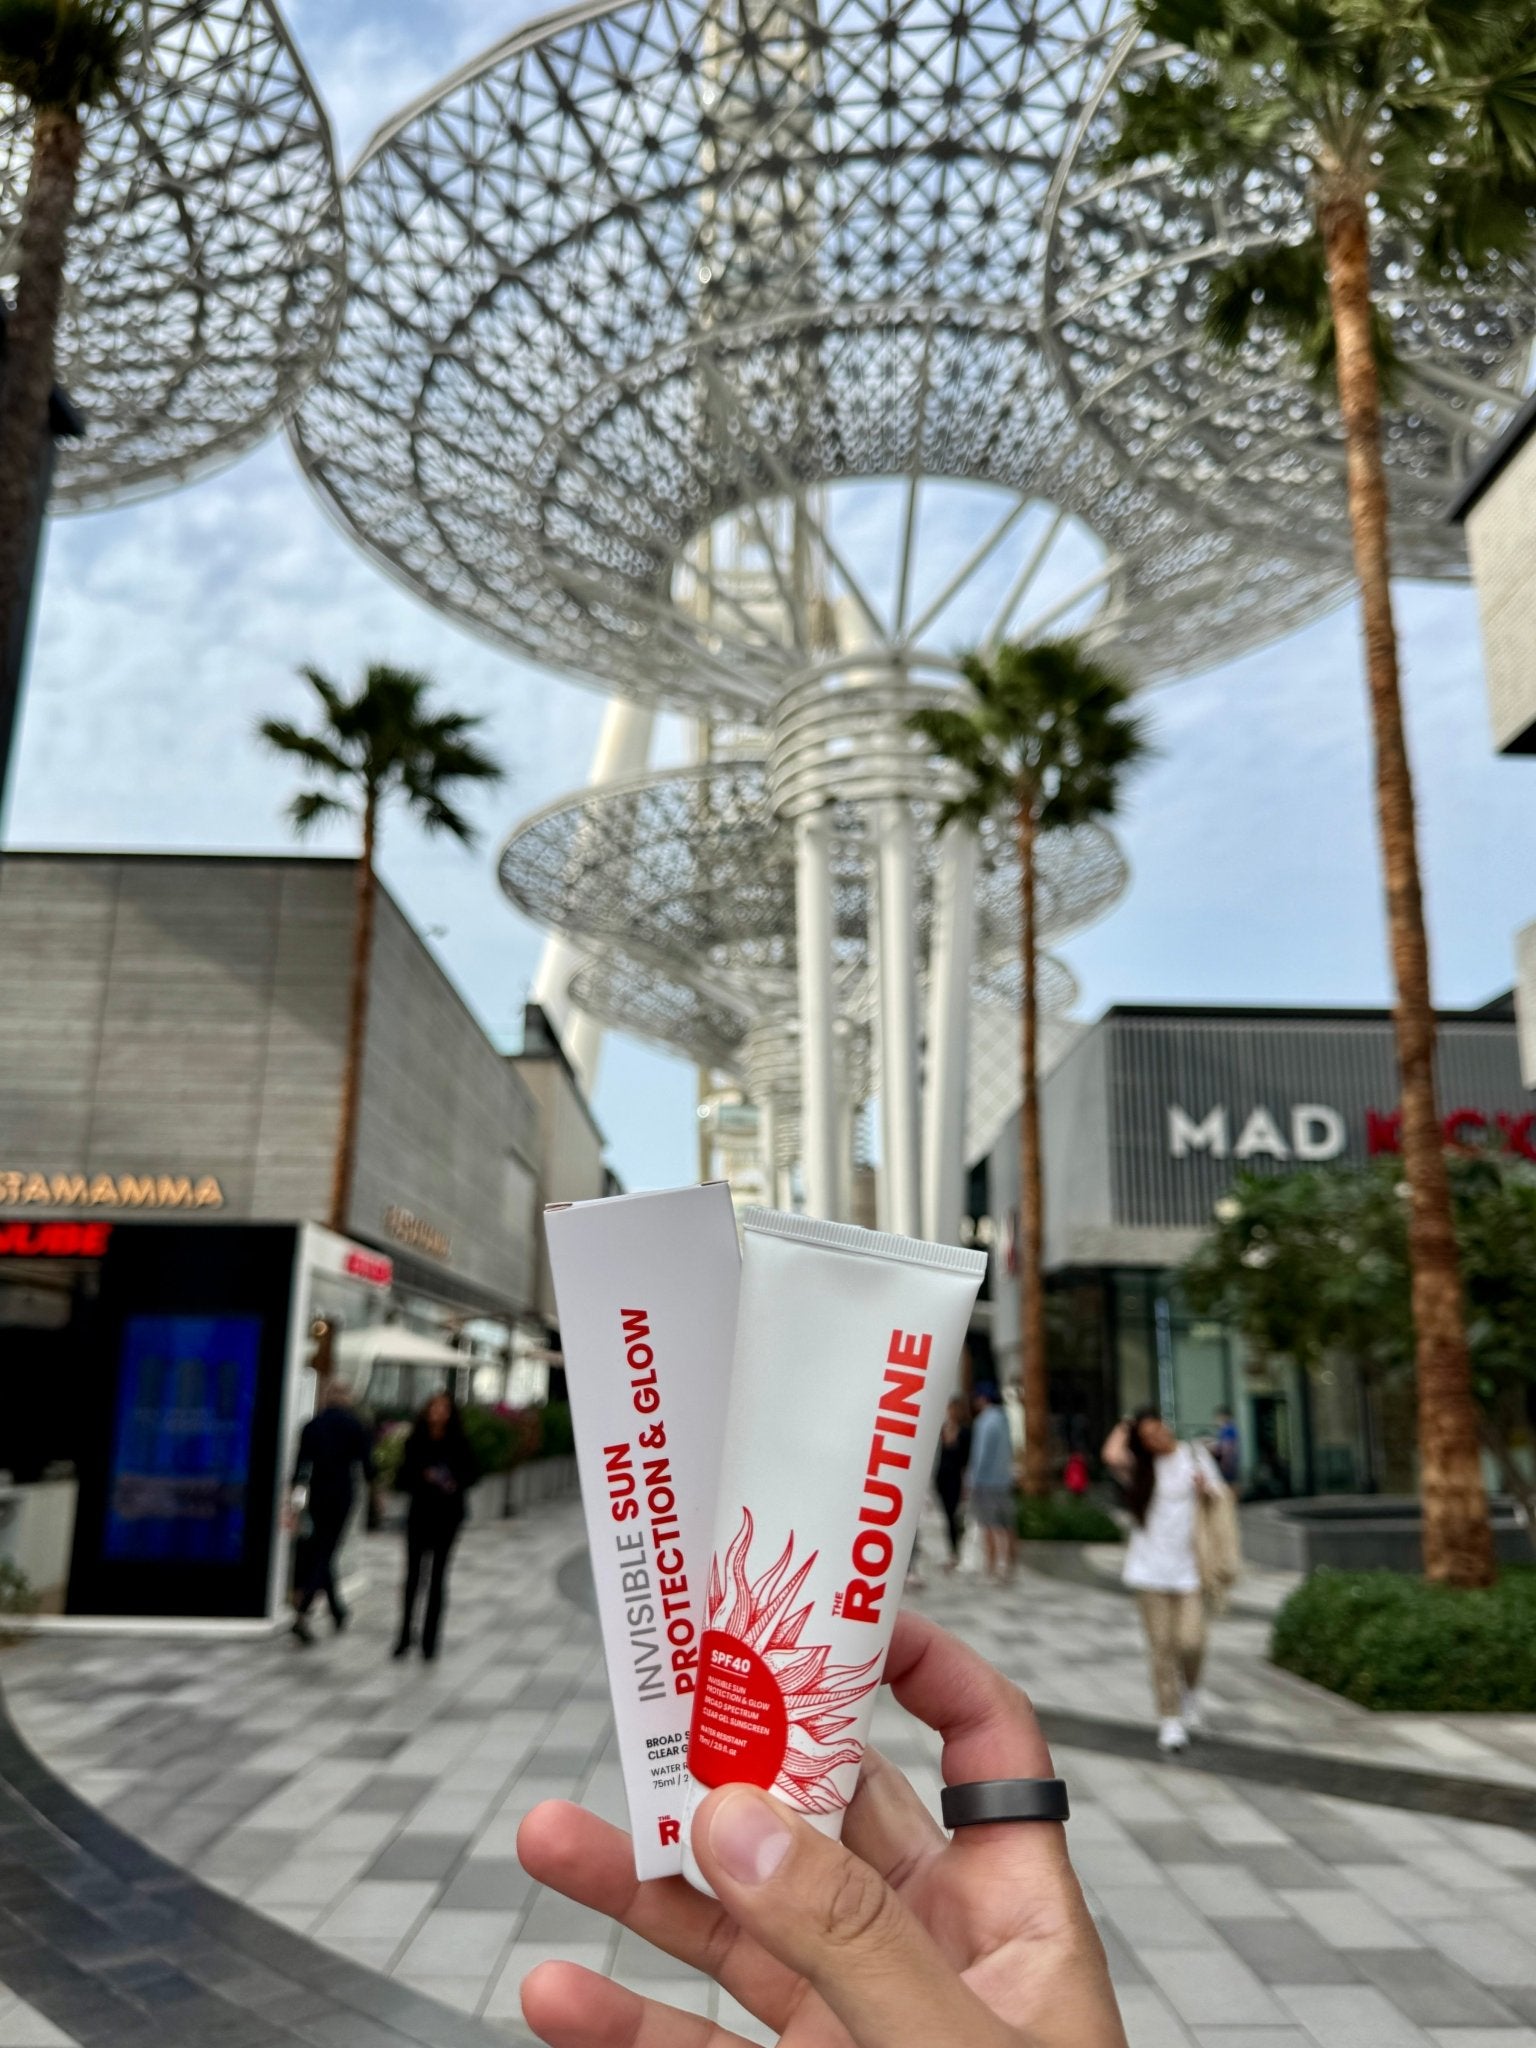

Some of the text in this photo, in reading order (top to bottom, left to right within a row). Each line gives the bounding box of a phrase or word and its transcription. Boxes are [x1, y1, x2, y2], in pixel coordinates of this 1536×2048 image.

[1168, 1102, 1346, 1161] MAD
[841, 1328, 932, 1624] ROUTINE
[620, 1309, 699, 1695] PROTECTION & GLOW
[603, 1443, 666, 1701] INVISIBLE SUN
[832, 1591, 844, 1617] THE
[711, 1649, 751, 1673] SPF40
[706, 1684, 741, 1702] PROTECTION
[748, 1699, 770, 1710] GLOW
[732, 1684, 747, 1695] SUN
[704, 1695, 760, 1720] BROAD SPECTRUM
[702, 1707, 770, 1735] CLEAR GEL SUNSCREEN
[646, 1733, 682, 1748] BROAD
[717, 1731, 748, 1747] RESISTANT
[648, 1746, 679, 1760] CLEAR
[651, 1763, 680, 1777] WATER
[653, 1777, 675, 1789] 75ml
